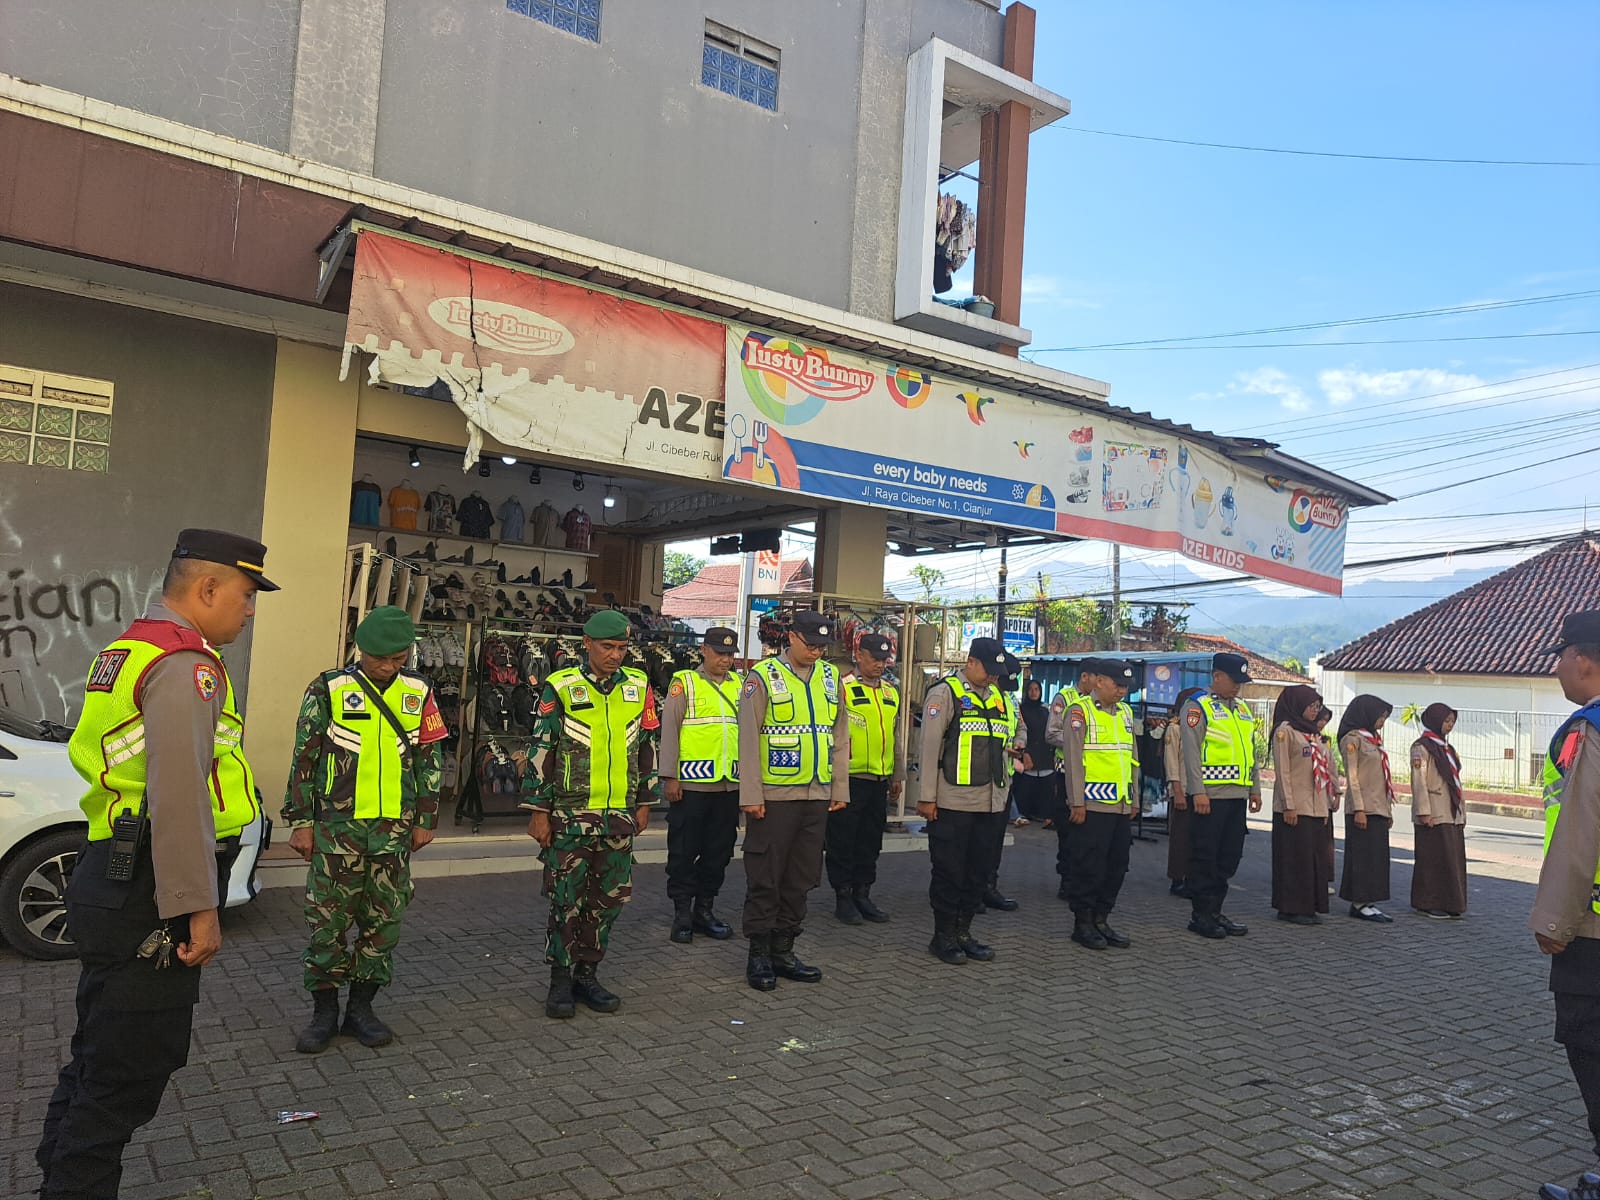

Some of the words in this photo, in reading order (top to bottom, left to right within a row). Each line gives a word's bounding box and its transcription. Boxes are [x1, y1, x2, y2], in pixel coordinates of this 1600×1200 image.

[448, 301, 501, 332] Lusty
[501, 314, 562, 345] Bunny
[746, 339, 805, 375] Lusty
[805, 354, 873, 391] Bunny
[646, 440, 657, 452] Jl.
[661, 443, 700, 460] Cibeber
[702, 450, 723, 463] Ruk
[873, 462, 911, 483] every
[913, 465, 947, 489] baby
[949, 477, 988, 493] needs
[861, 486, 872, 497] Jl.
[875, 487, 899, 502] Raya
[901, 491, 936, 507] Cibeber
[962, 502, 993, 517] Cianjur
[1182, 537, 1210, 561] AZEL
[1212, 547, 1246, 570] KIDS
[758, 567, 777, 581] BNI
[1003, 618, 1032, 633] APOTEK
